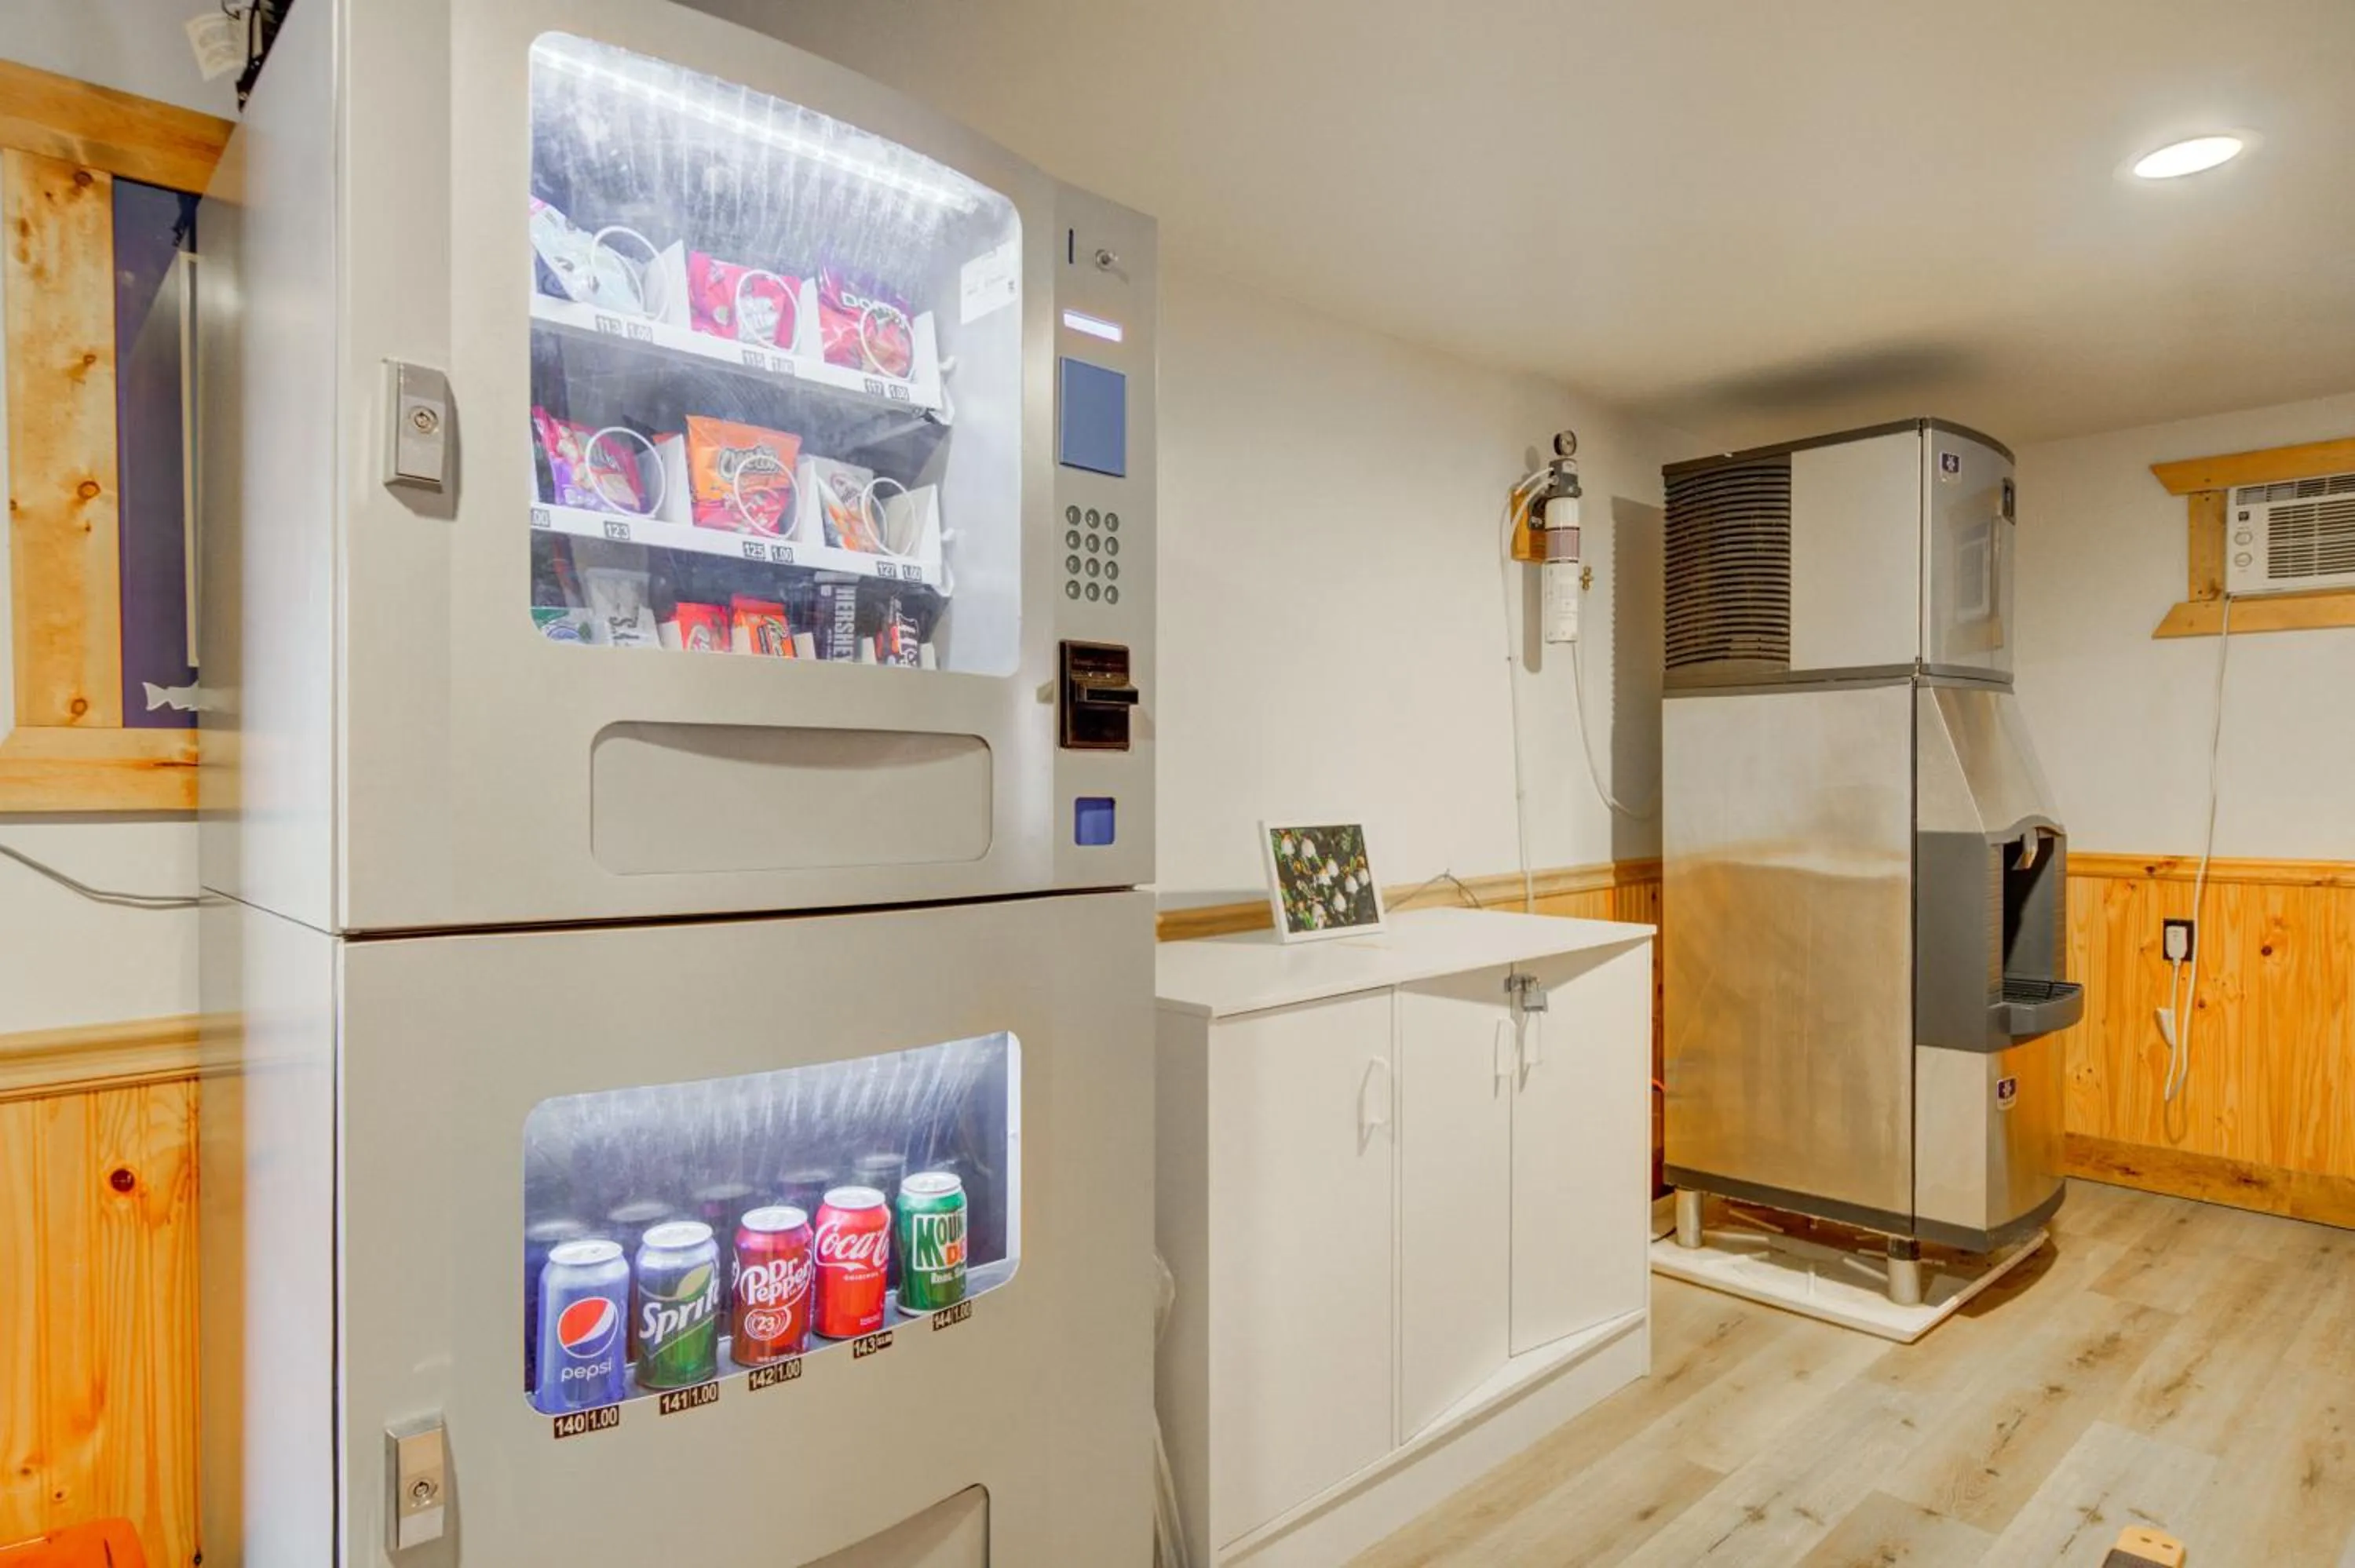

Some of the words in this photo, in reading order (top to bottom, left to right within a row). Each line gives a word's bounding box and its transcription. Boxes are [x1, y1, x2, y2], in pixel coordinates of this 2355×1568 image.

[604, 523, 630, 540] 123
[744, 542, 765, 560] 125
[878, 562, 896, 578] 127
[769, 1257, 798, 1283] Dr
[741, 1260, 812, 1307] Pepper
[756, 1315, 776, 1332] 23
[855, 1335, 876, 1357] 143
[560, 1357, 612, 1383] pepsi
[750, 1366, 776, 1388] 142
[778, 1358, 801, 1381] 1.00
[661, 1391, 689, 1413] 141
[691, 1384, 717, 1407] 1.00
[555, 1413, 586, 1437] 140
[589, 1406, 619, 1430] 1.00
